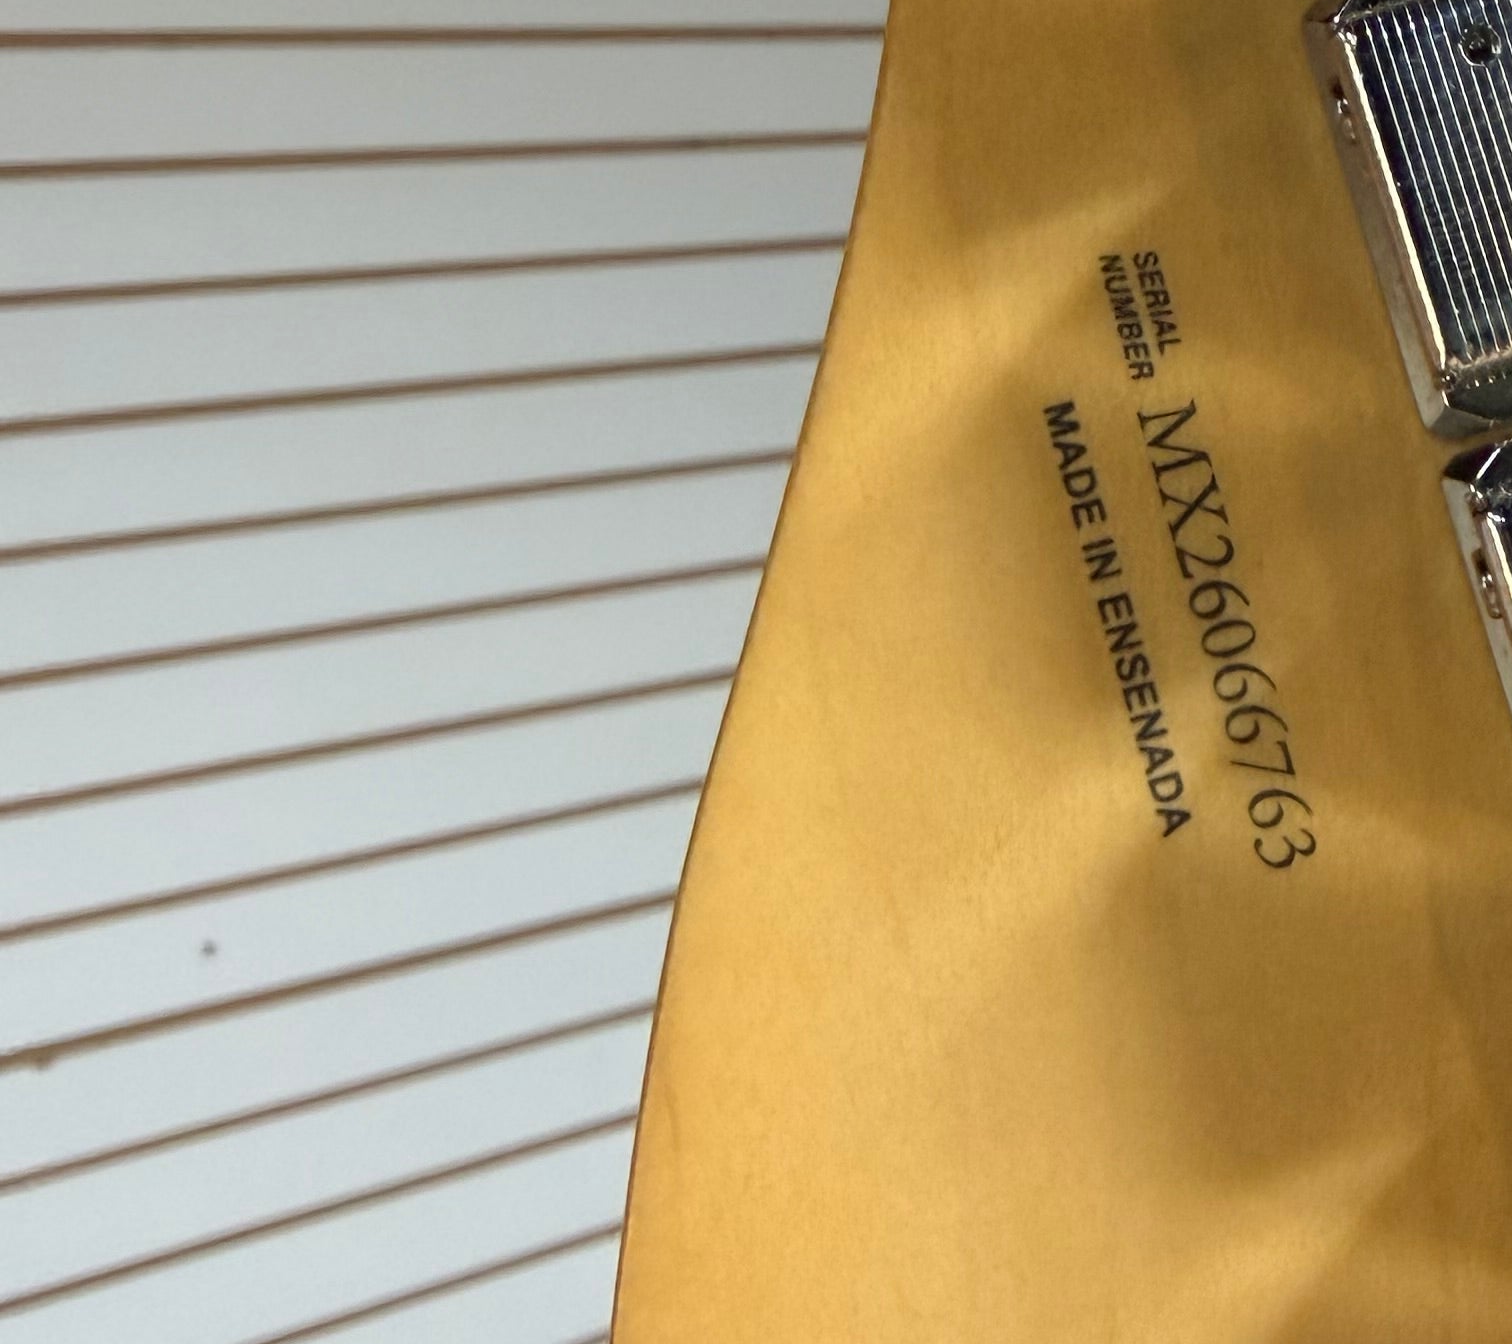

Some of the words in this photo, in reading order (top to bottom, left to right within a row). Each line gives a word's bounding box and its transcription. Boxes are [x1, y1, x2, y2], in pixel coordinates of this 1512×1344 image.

[1098, 254, 1155, 380] NUMBER
[1132, 251, 1182, 356] SERIAL
[1044, 400, 1107, 530] MADE
[1081, 537, 1122, 583] IN
[1137, 398, 1317, 869] MX26066763
[1097, 591, 1192, 839] ENSENADA
